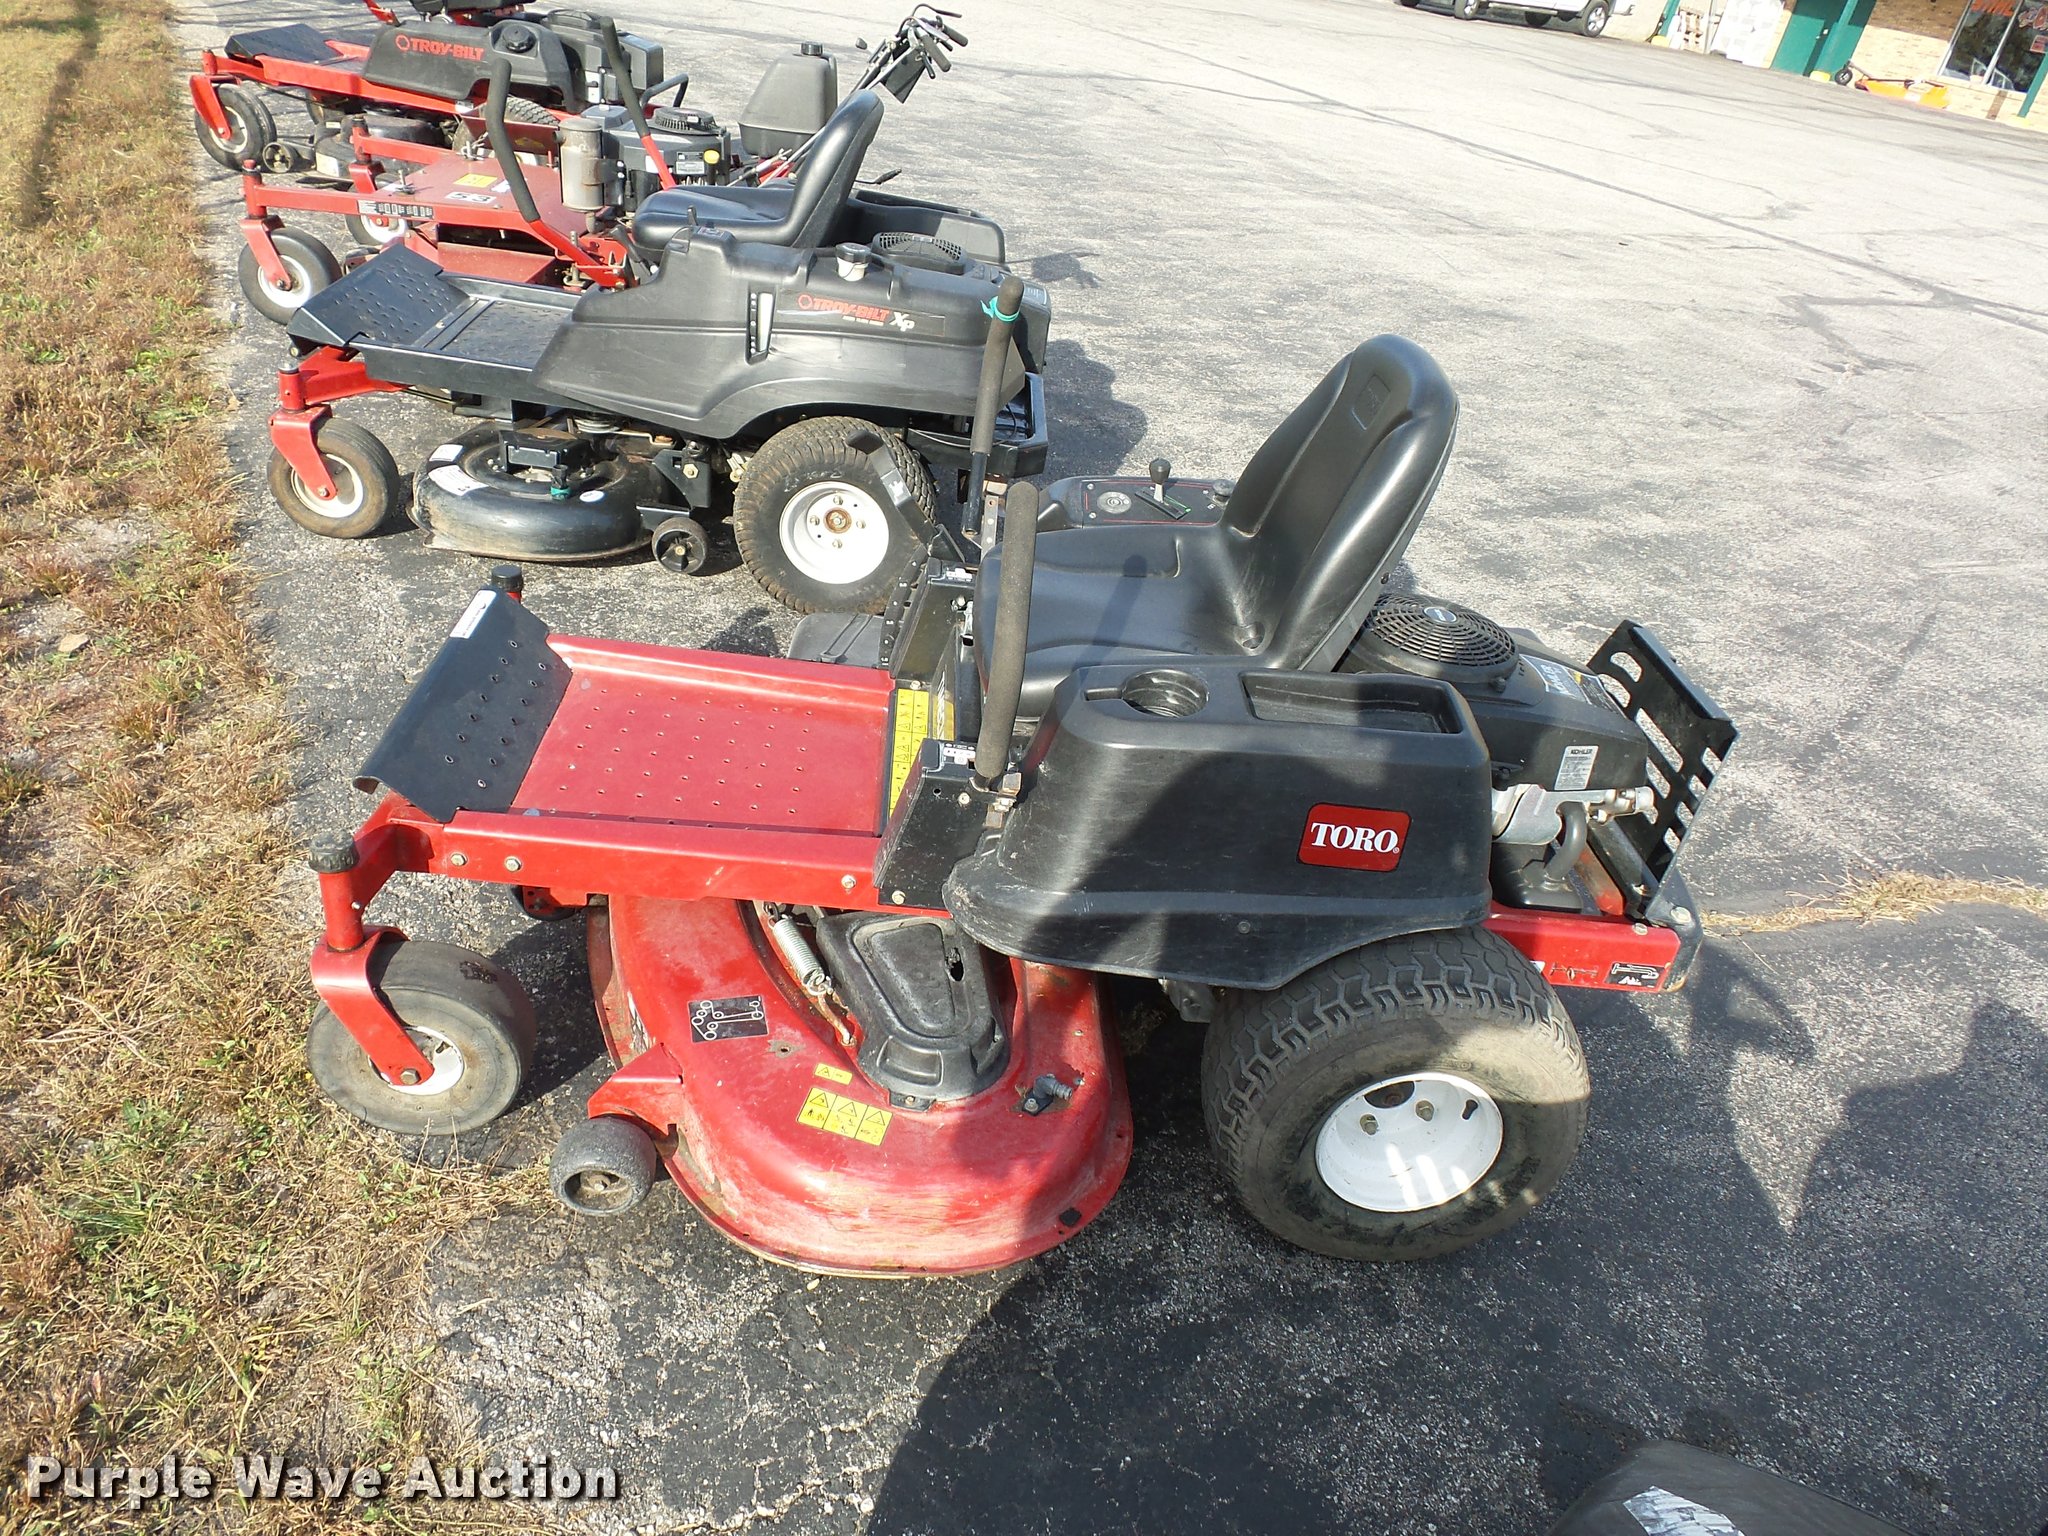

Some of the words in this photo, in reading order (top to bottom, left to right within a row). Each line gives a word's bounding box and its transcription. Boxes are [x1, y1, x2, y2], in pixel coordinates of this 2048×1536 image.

[410, 37, 485, 61] TROY-BILT
[812, 297, 890, 322] TROY-BILT
[1310, 821, 1399, 854] TORO
